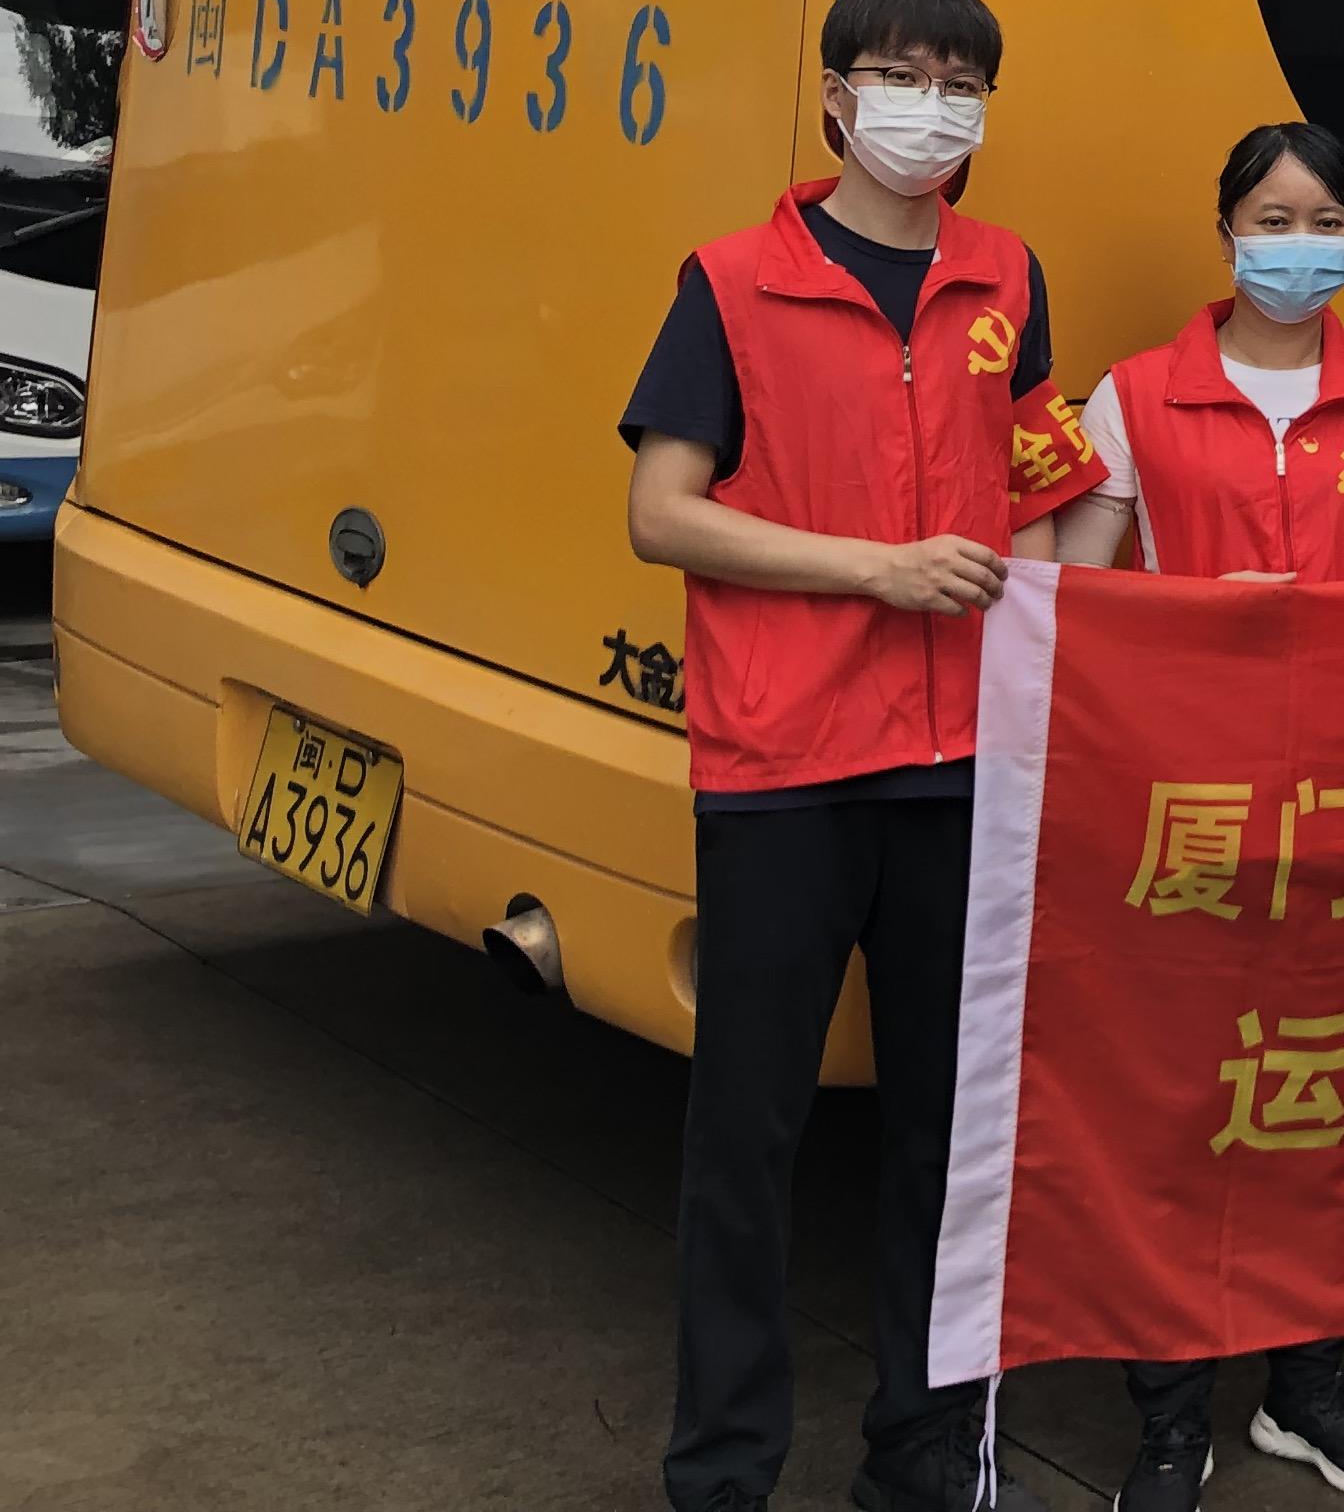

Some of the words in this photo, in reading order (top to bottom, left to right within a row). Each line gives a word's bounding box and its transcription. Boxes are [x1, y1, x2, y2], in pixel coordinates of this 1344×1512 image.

[1010, 394, 1095, 504] 全员
[599, 628, 686, 714] 大金
[245, 771, 376, 901] A3936
